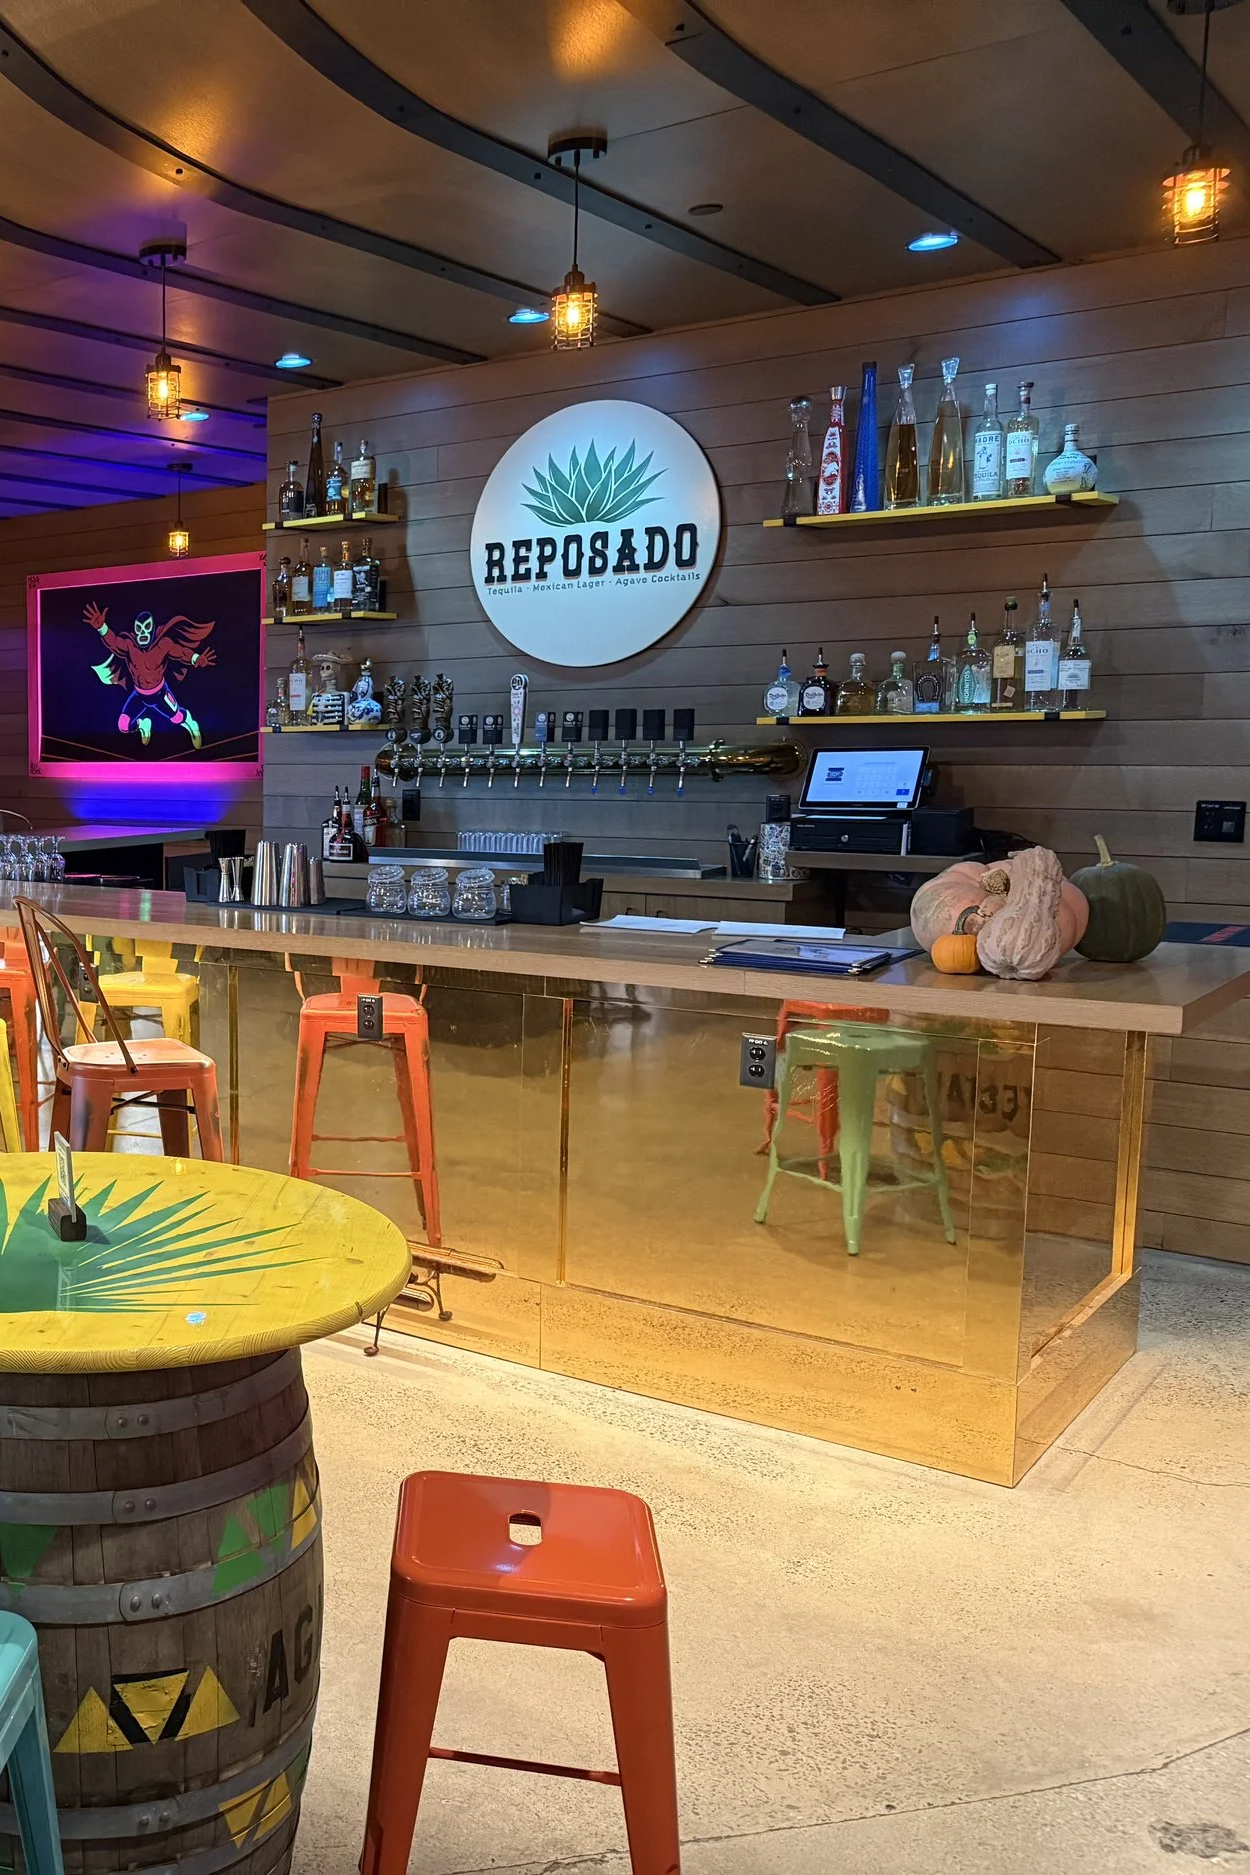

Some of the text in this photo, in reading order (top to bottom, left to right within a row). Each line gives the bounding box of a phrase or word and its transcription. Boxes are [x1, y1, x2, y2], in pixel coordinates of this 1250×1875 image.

[484, 522, 700, 584] REPOSADO
[488, 572, 701, 596] Tequila Mexican Lager Agave Cocktails
